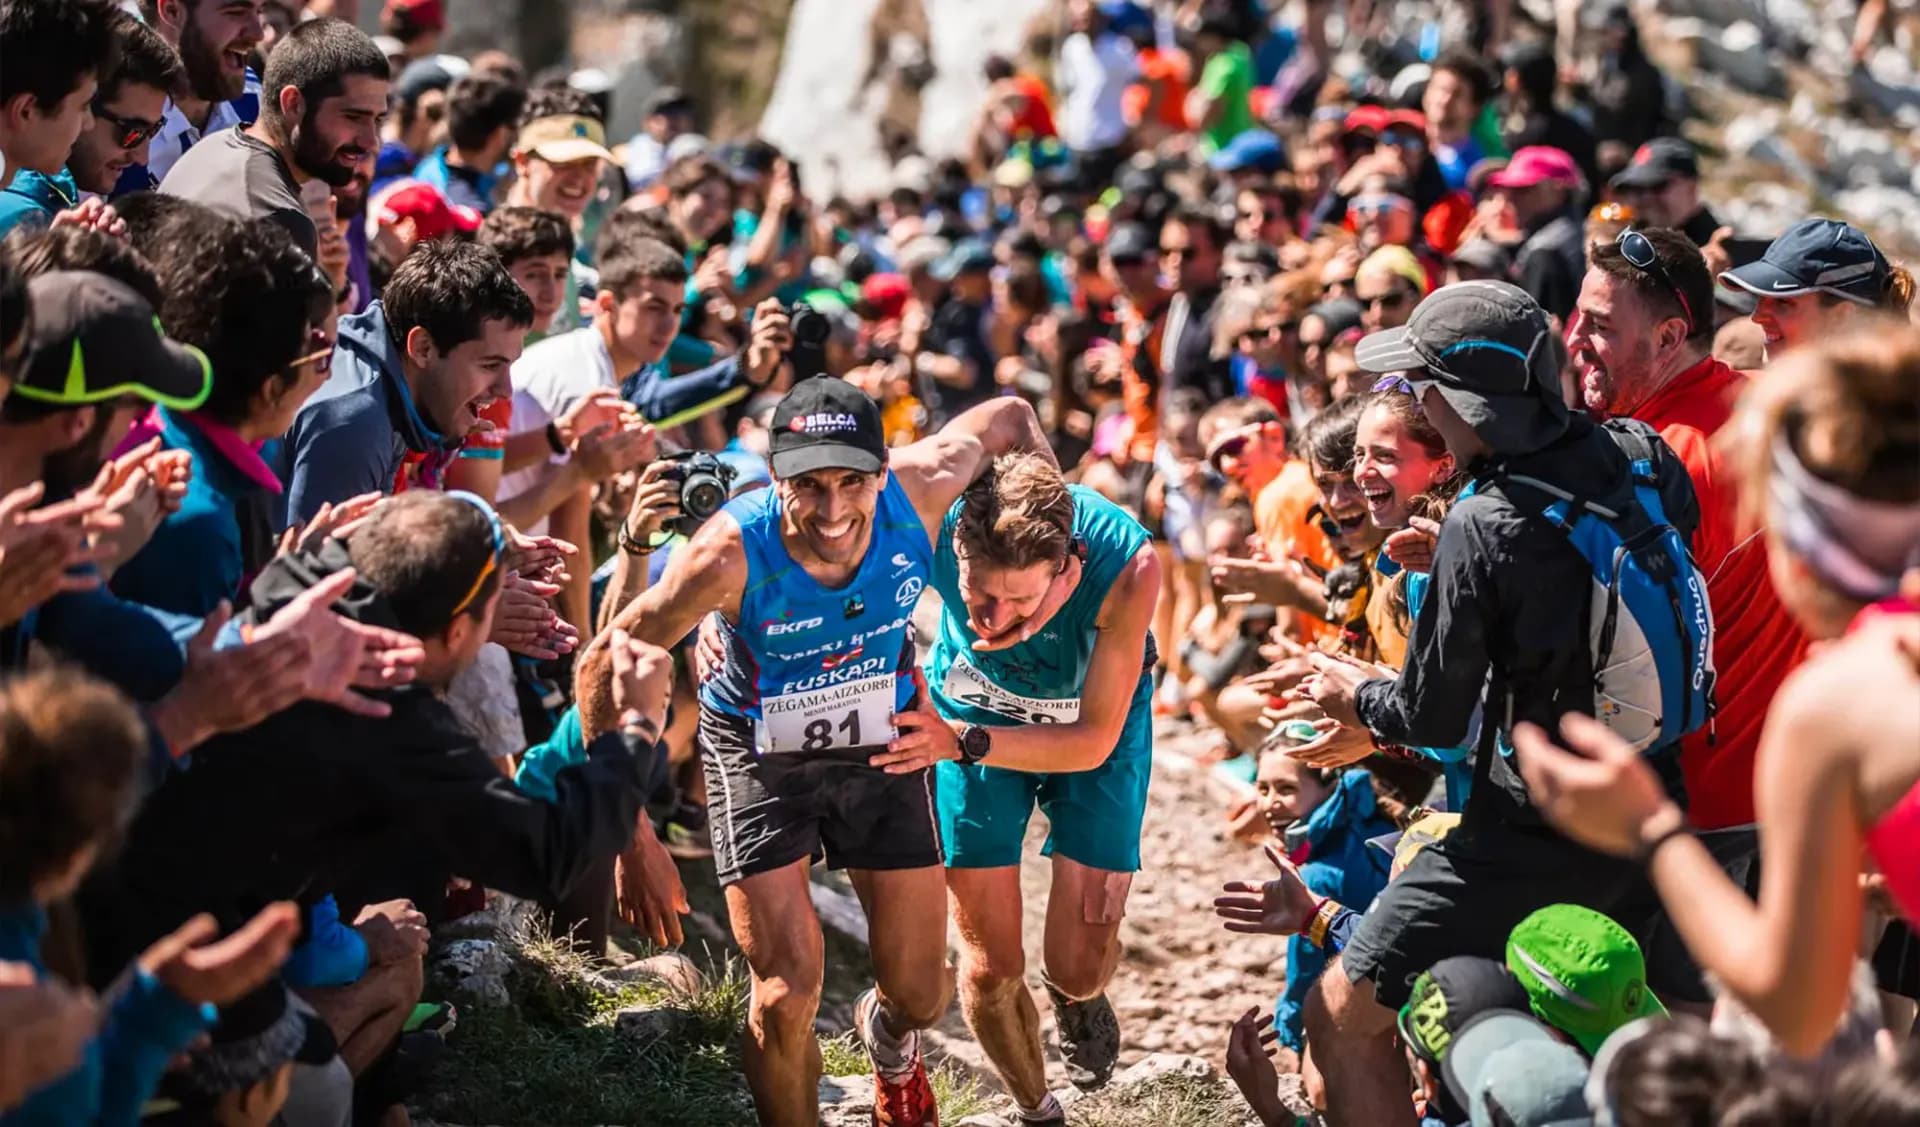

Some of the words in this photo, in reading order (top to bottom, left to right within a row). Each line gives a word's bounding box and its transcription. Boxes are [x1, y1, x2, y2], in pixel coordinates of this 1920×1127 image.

[805, 413, 857, 427] BELCA
[1687, 576, 1709, 691] Quechua
[781, 656, 887, 696] EUSKADI
[801, 709, 862, 752] 81
